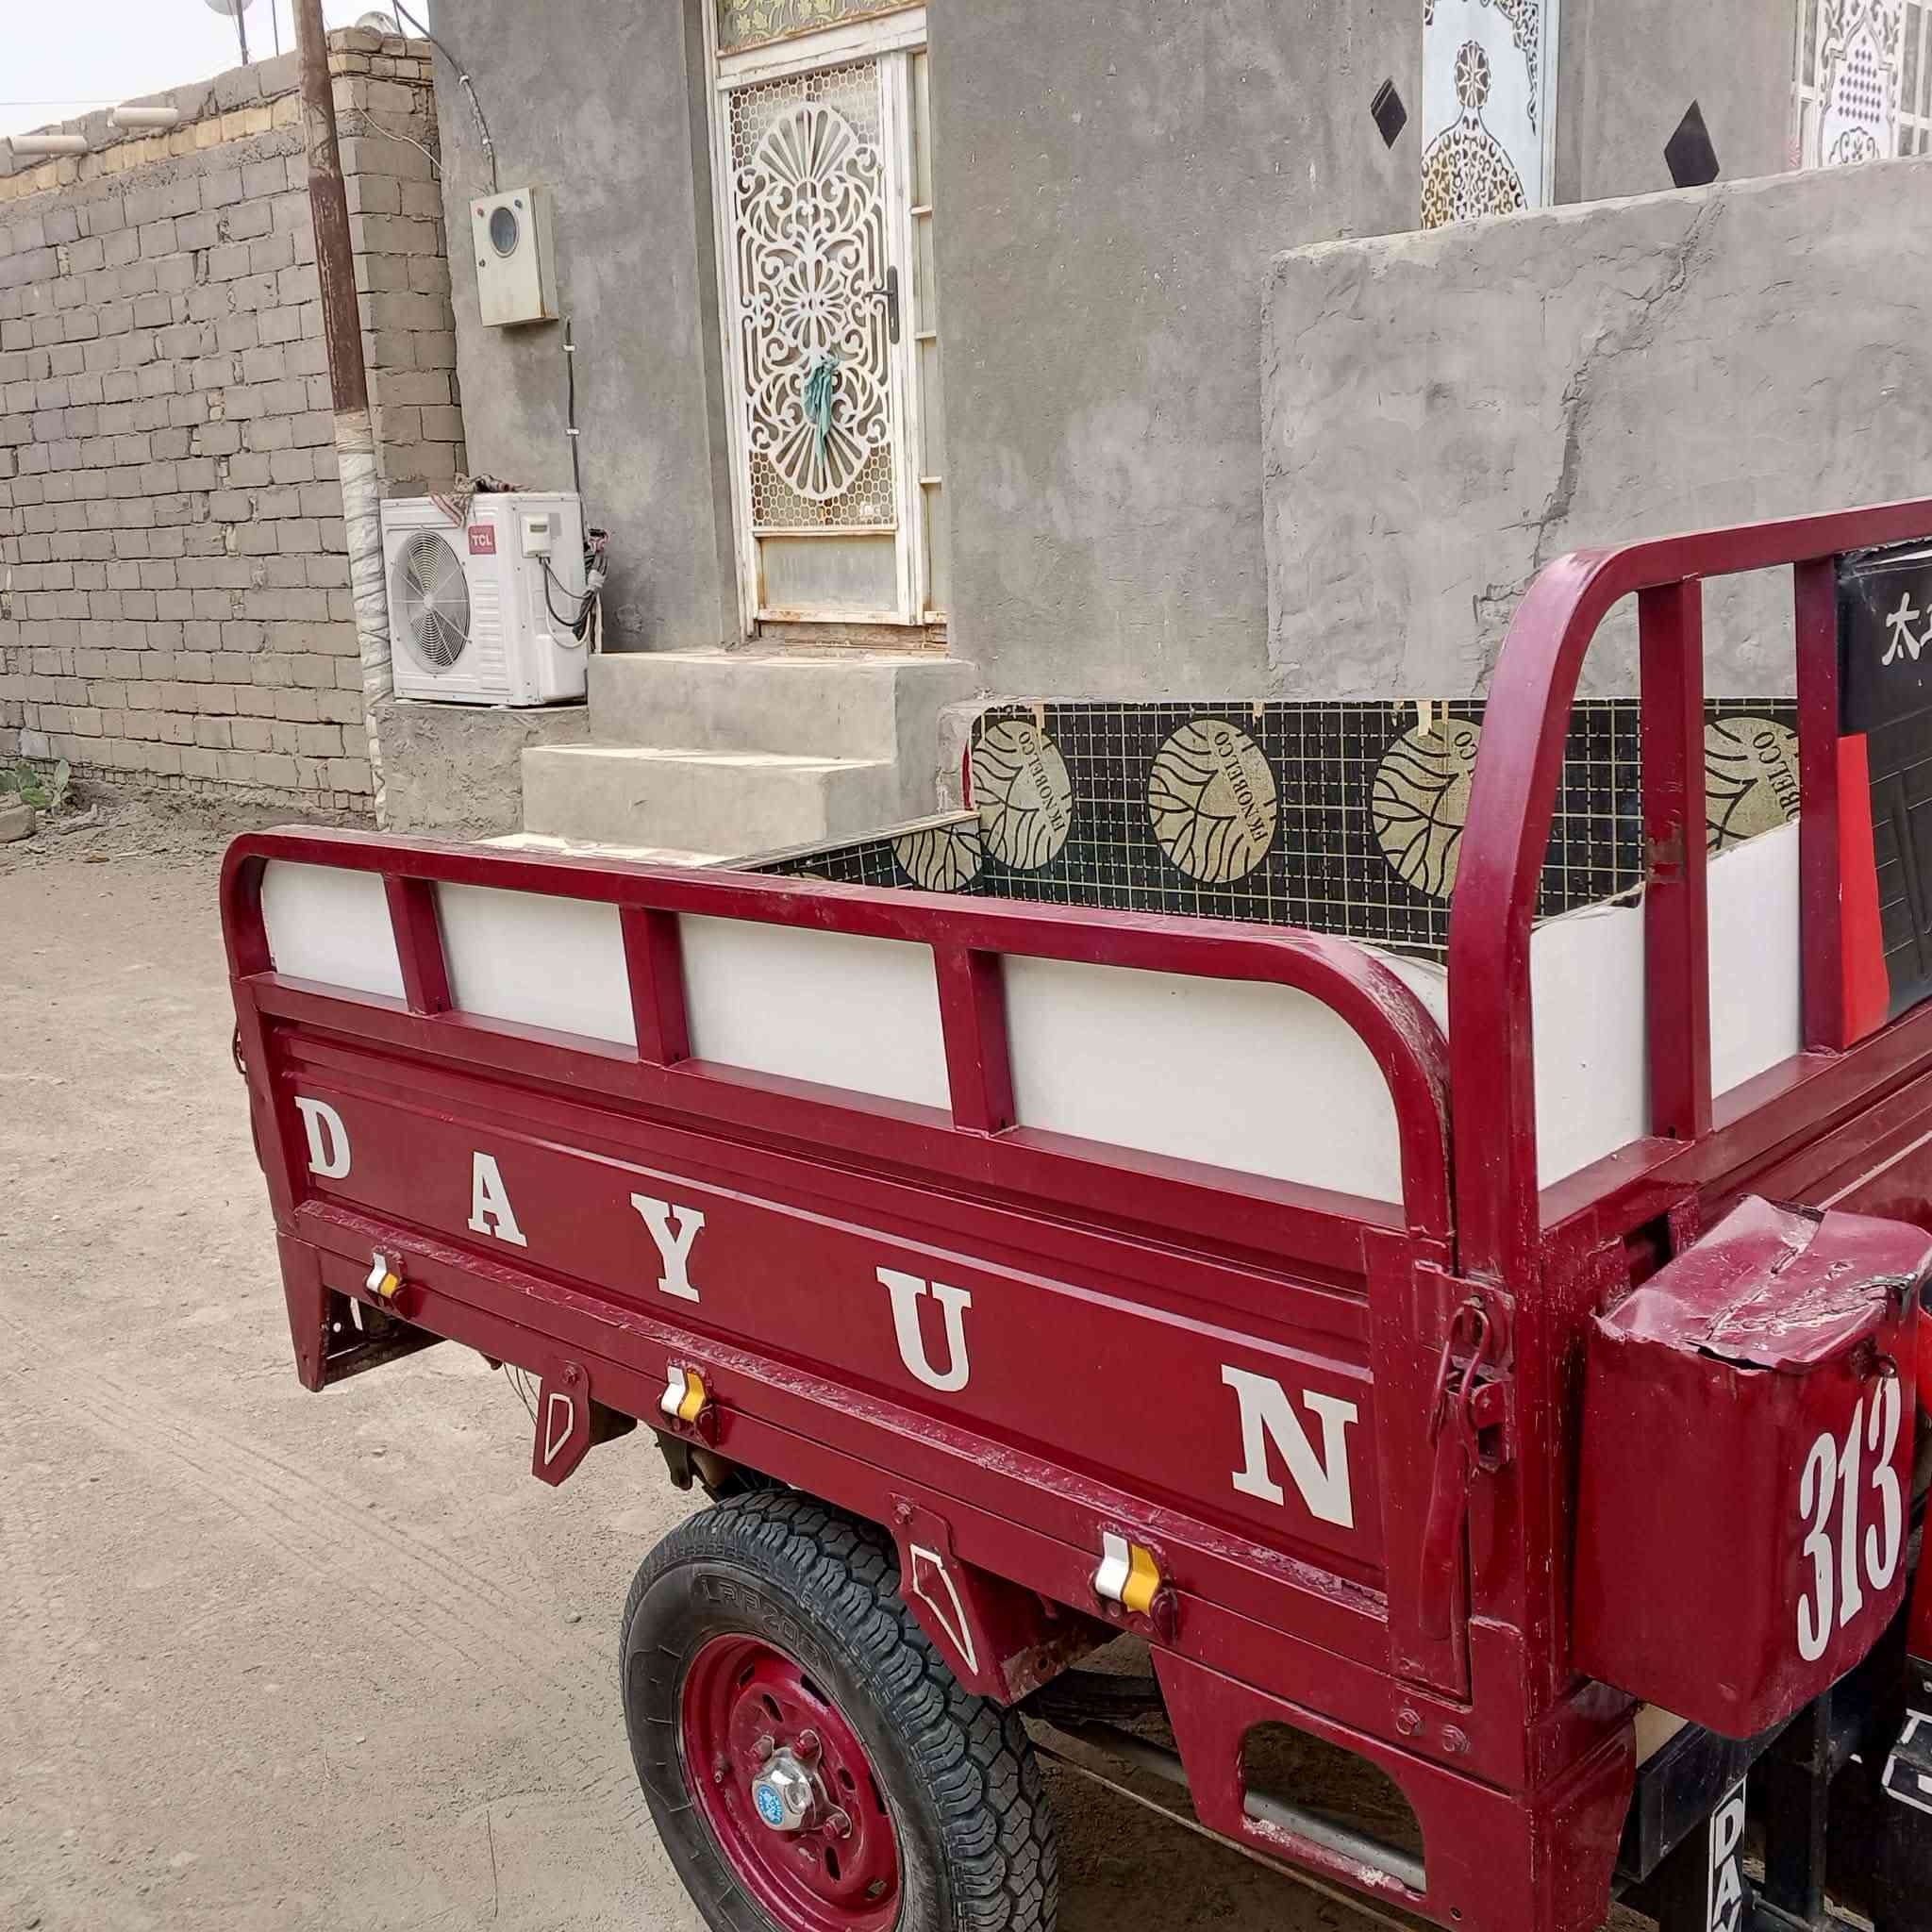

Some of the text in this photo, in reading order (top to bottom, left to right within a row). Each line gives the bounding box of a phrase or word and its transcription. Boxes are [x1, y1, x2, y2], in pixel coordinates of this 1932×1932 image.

[471, 534, 492, 546] TCL
[1882, 591, 1932, 666] 太
[1797, 1375, 1903, 1662] 313
